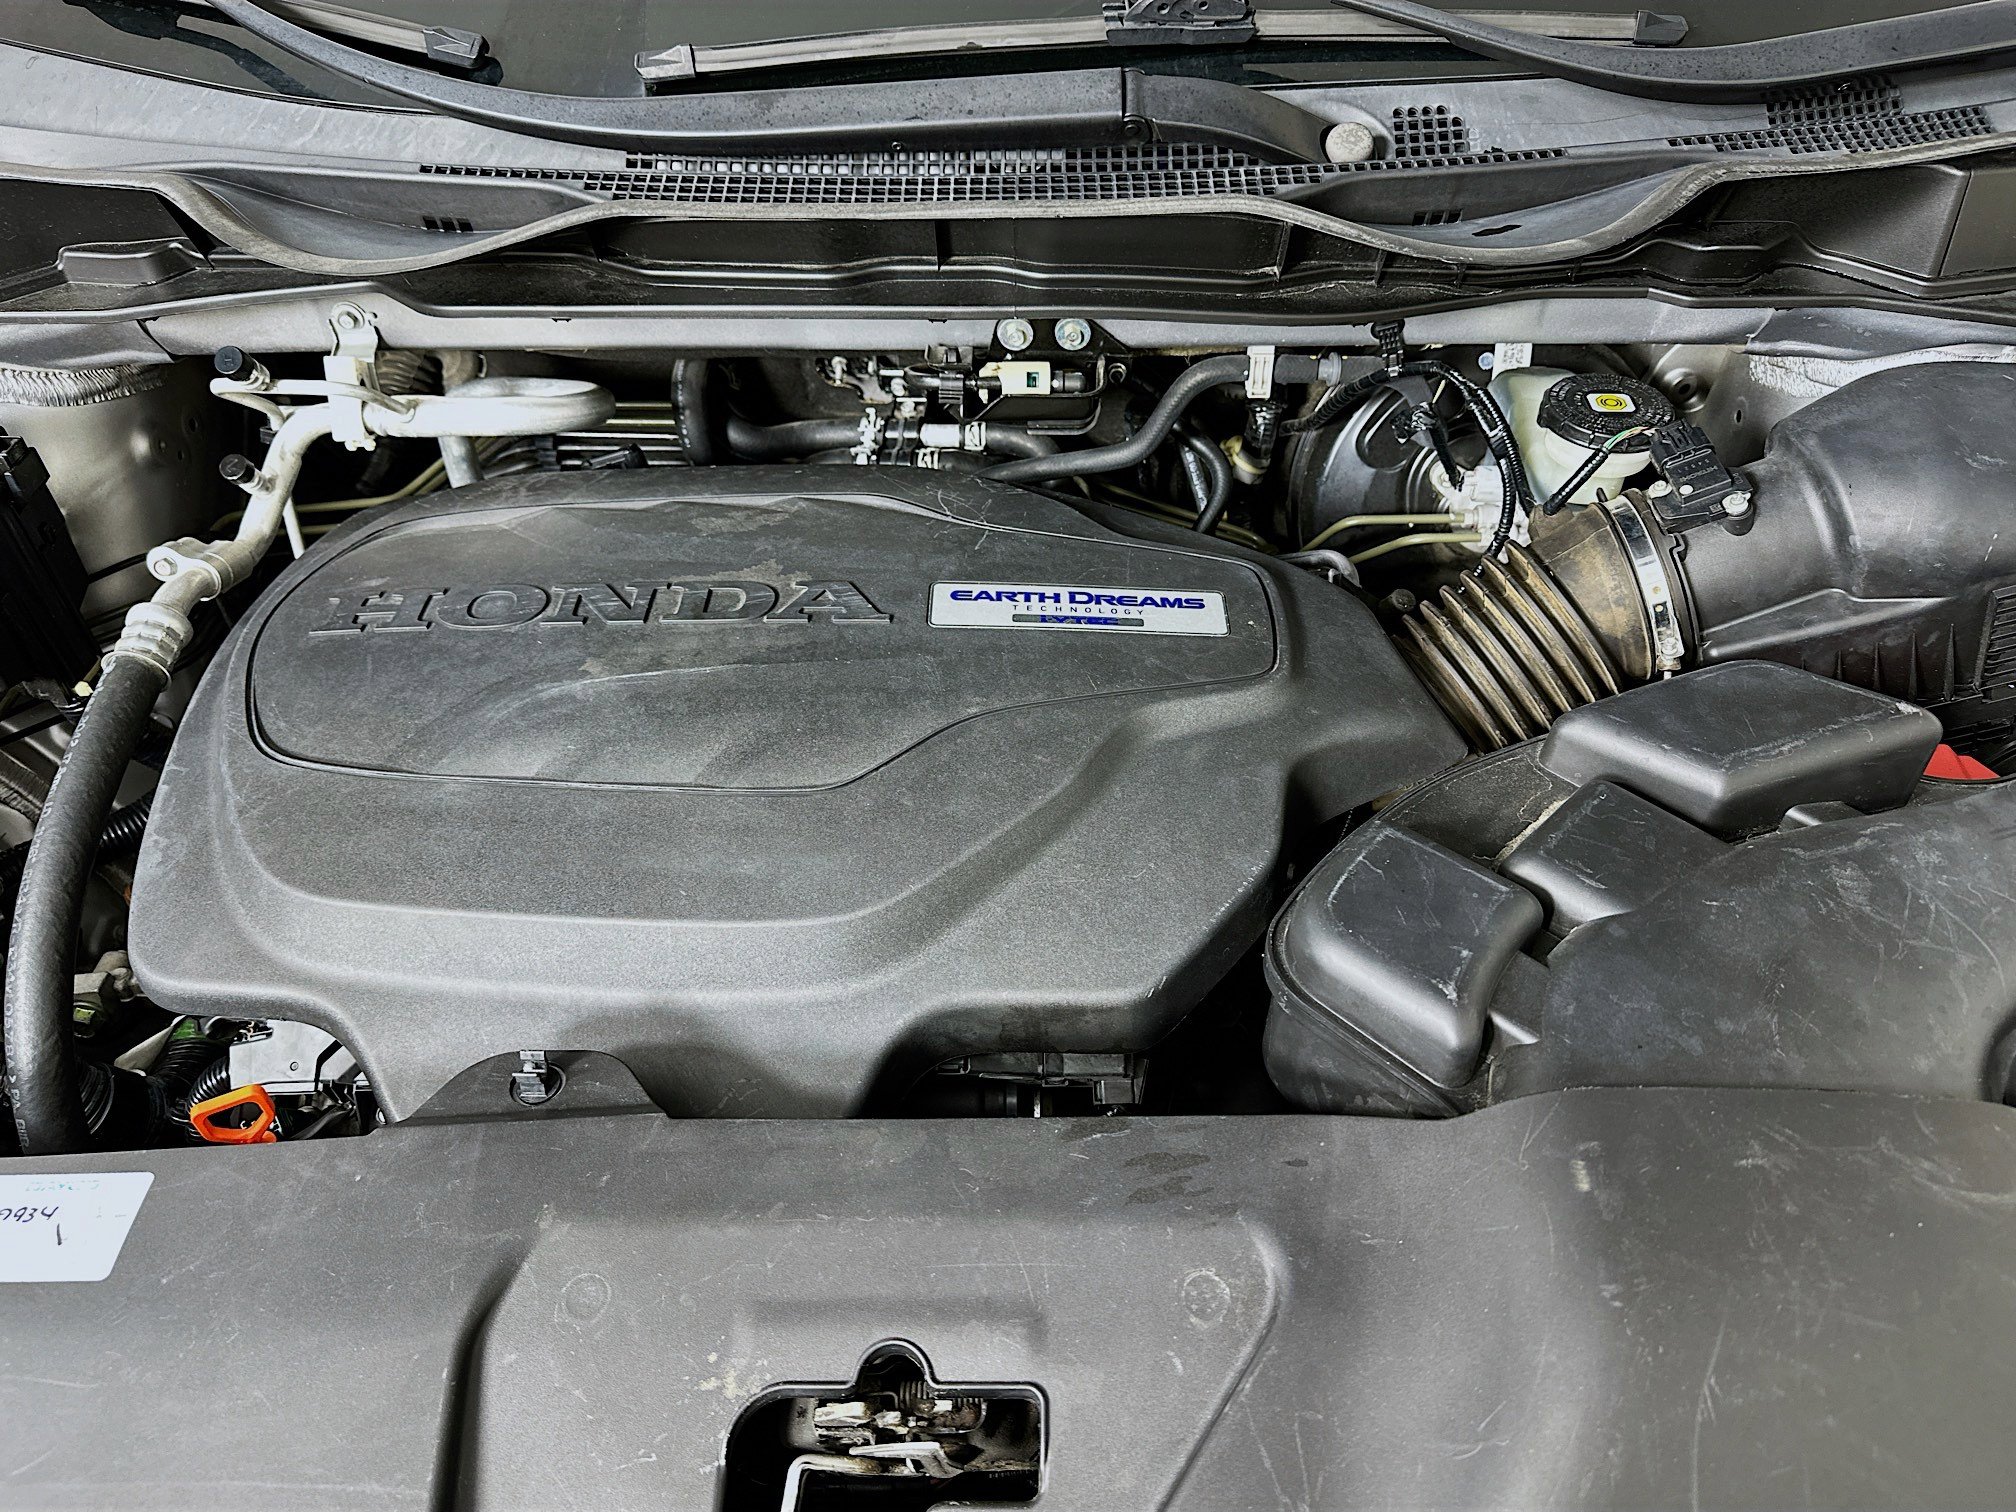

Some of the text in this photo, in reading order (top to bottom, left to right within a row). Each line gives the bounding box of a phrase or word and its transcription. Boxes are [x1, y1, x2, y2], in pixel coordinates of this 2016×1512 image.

[309, 581, 894, 635] HONDA
[950, 590, 1206, 610] EARTH DREAMS
[1013, 604, 1144, 616] TECHNOLOGY
